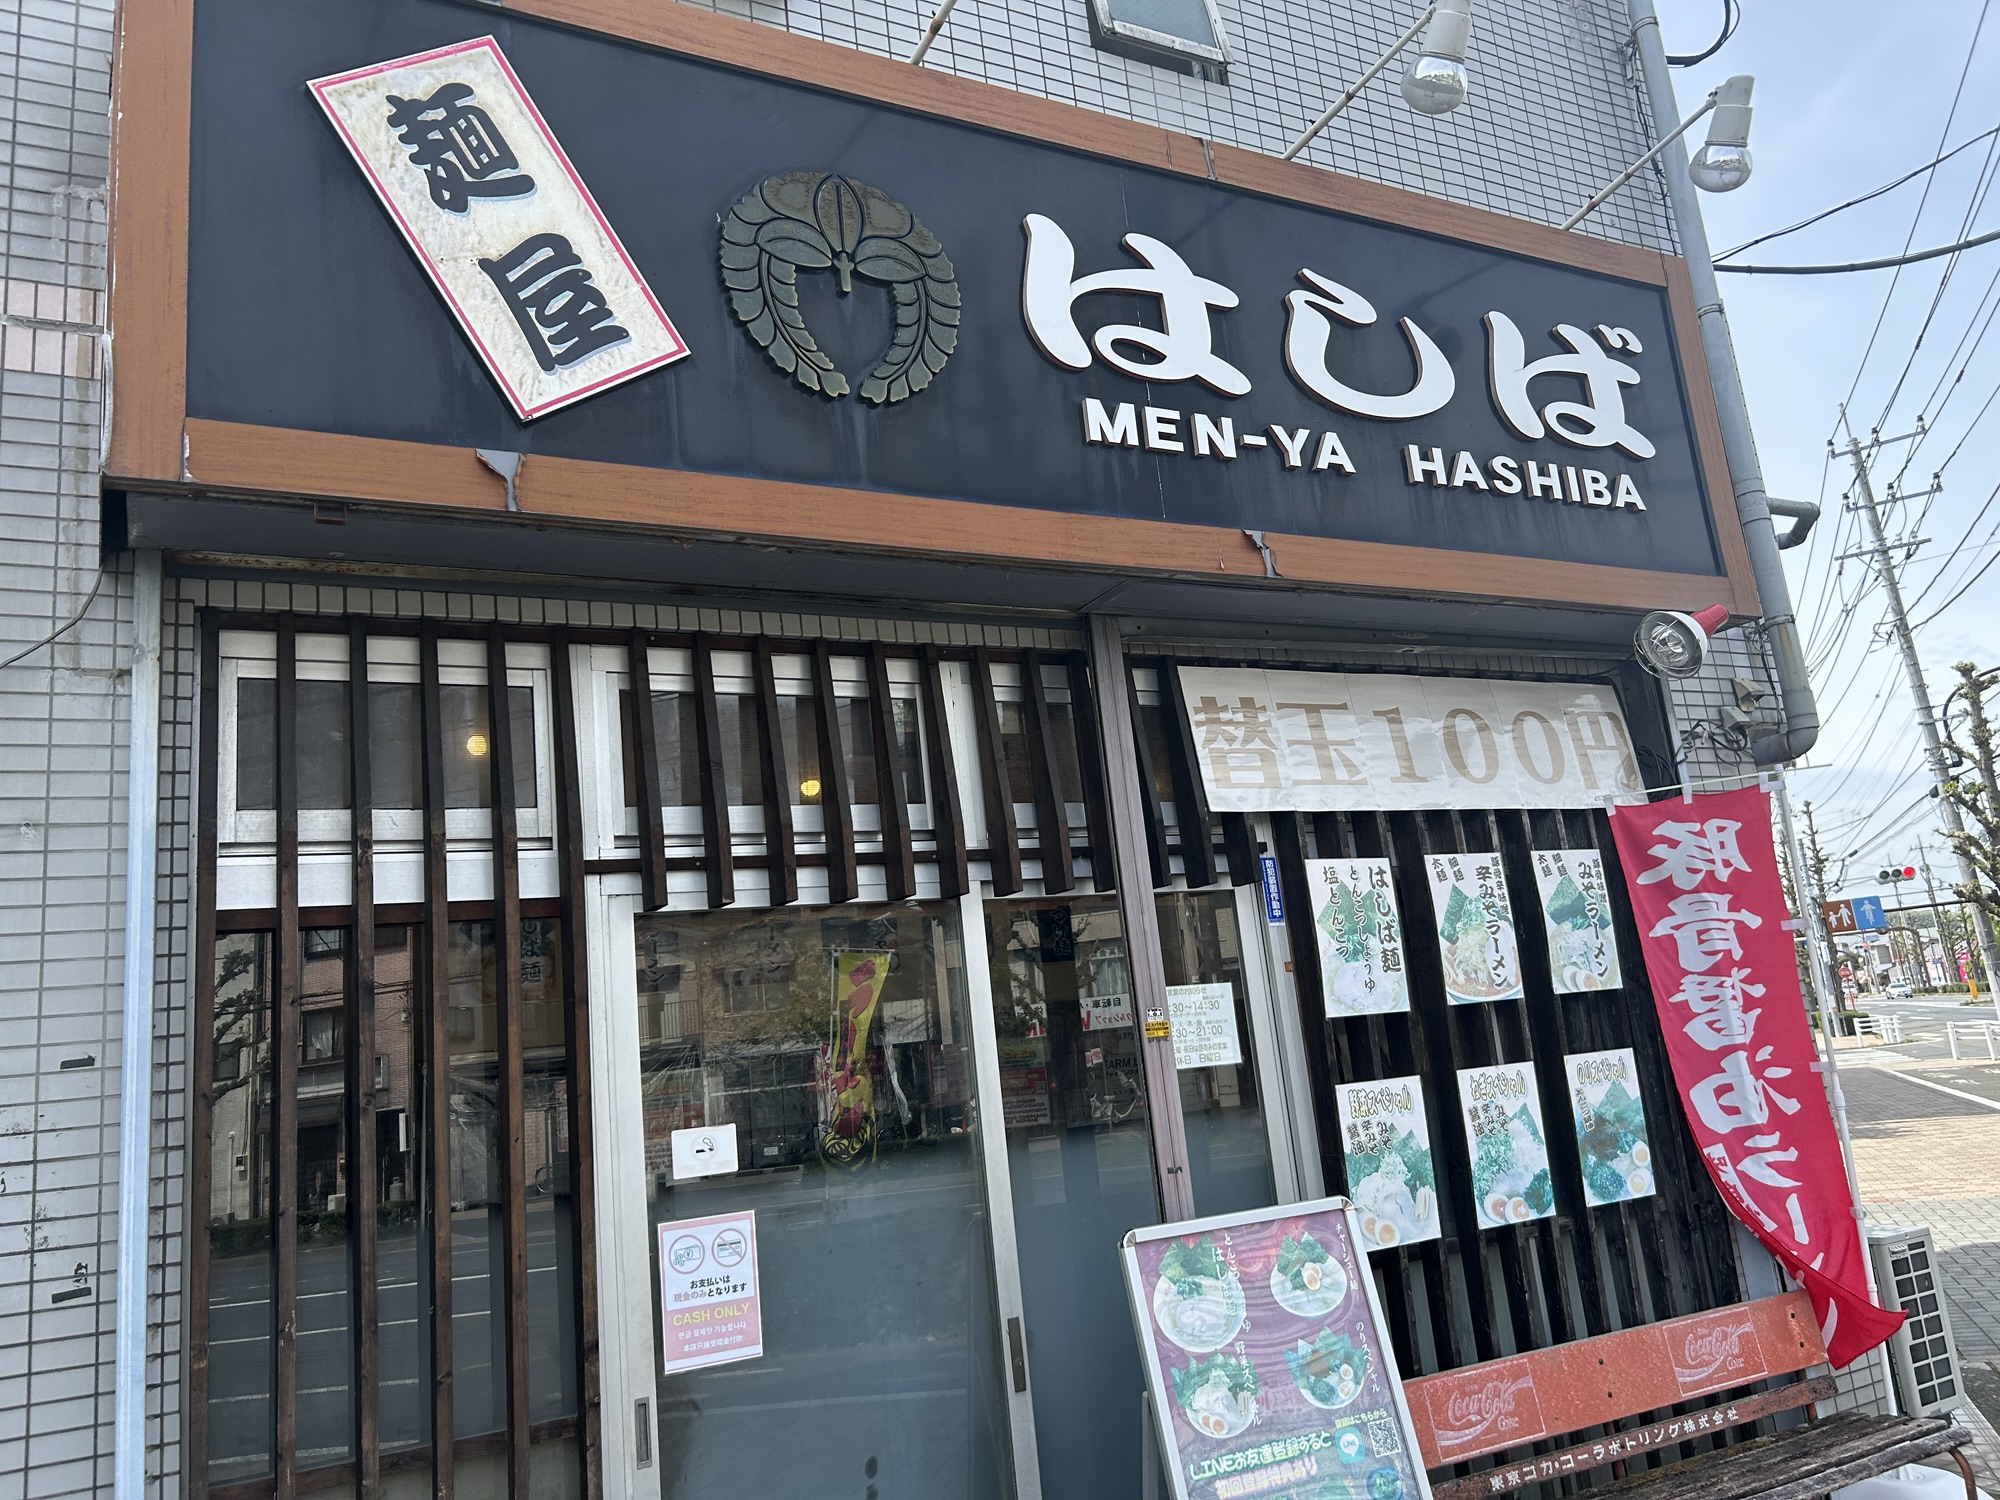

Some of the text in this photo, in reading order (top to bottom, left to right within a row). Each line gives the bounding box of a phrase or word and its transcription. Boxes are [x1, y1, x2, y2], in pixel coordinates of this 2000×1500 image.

[384, 81, 632, 376] 麺屋
[1022, 212, 1656, 460] はしば
[1082, 397, 1647, 512] MEN-YA HASHIBA
[1322, 866, 1350, 958] 塩とんこつ
[1350, 865, 1376, 994] とんこつしょうゆ
[1367, 865, 1402, 974] はしば麺
[1474, 865, 1509, 988] 辛みそラーメン
[1577, 861, 1608, 978] みそラーメン
[1199, 1052, 1222, 1063] 日曜日
[1347, 1083, 1412, 1119] 野菜スペシャル
[1469, 1070, 1526, 1102] ねぎスペシャル
[1346, 1122, 1366, 1156] 醤油
[1360, 1119, 1379, 1156] 辛みそ
[1376, 1121, 1392, 1151] みそ
[1467, 1105, 1485, 1137] 醤油
[1480, 1103, 1497, 1136] 辛みそ
[1494, 1104, 1509, 1132] みそ
[1335, 1223, 1359, 1291] チャーシュー麺
[673, 1282, 748, 1303] 現金のみとなります
[690, 1274, 731, 1290] お支払いは
[672, 1302, 751, 1326] CASH ONLY
[1355, 1321, 1381, 1393] のりスペシャル
[1447, 1378, 1516, 1426] Coca-Cola
[1497, 1415, 1520, 1431] Coke
[1188, 1430, 1334, 1481] LINEお友達登録すると
[1489, 1405, 1740, 1492] 東京コカ・コーラボトリング株式会社
